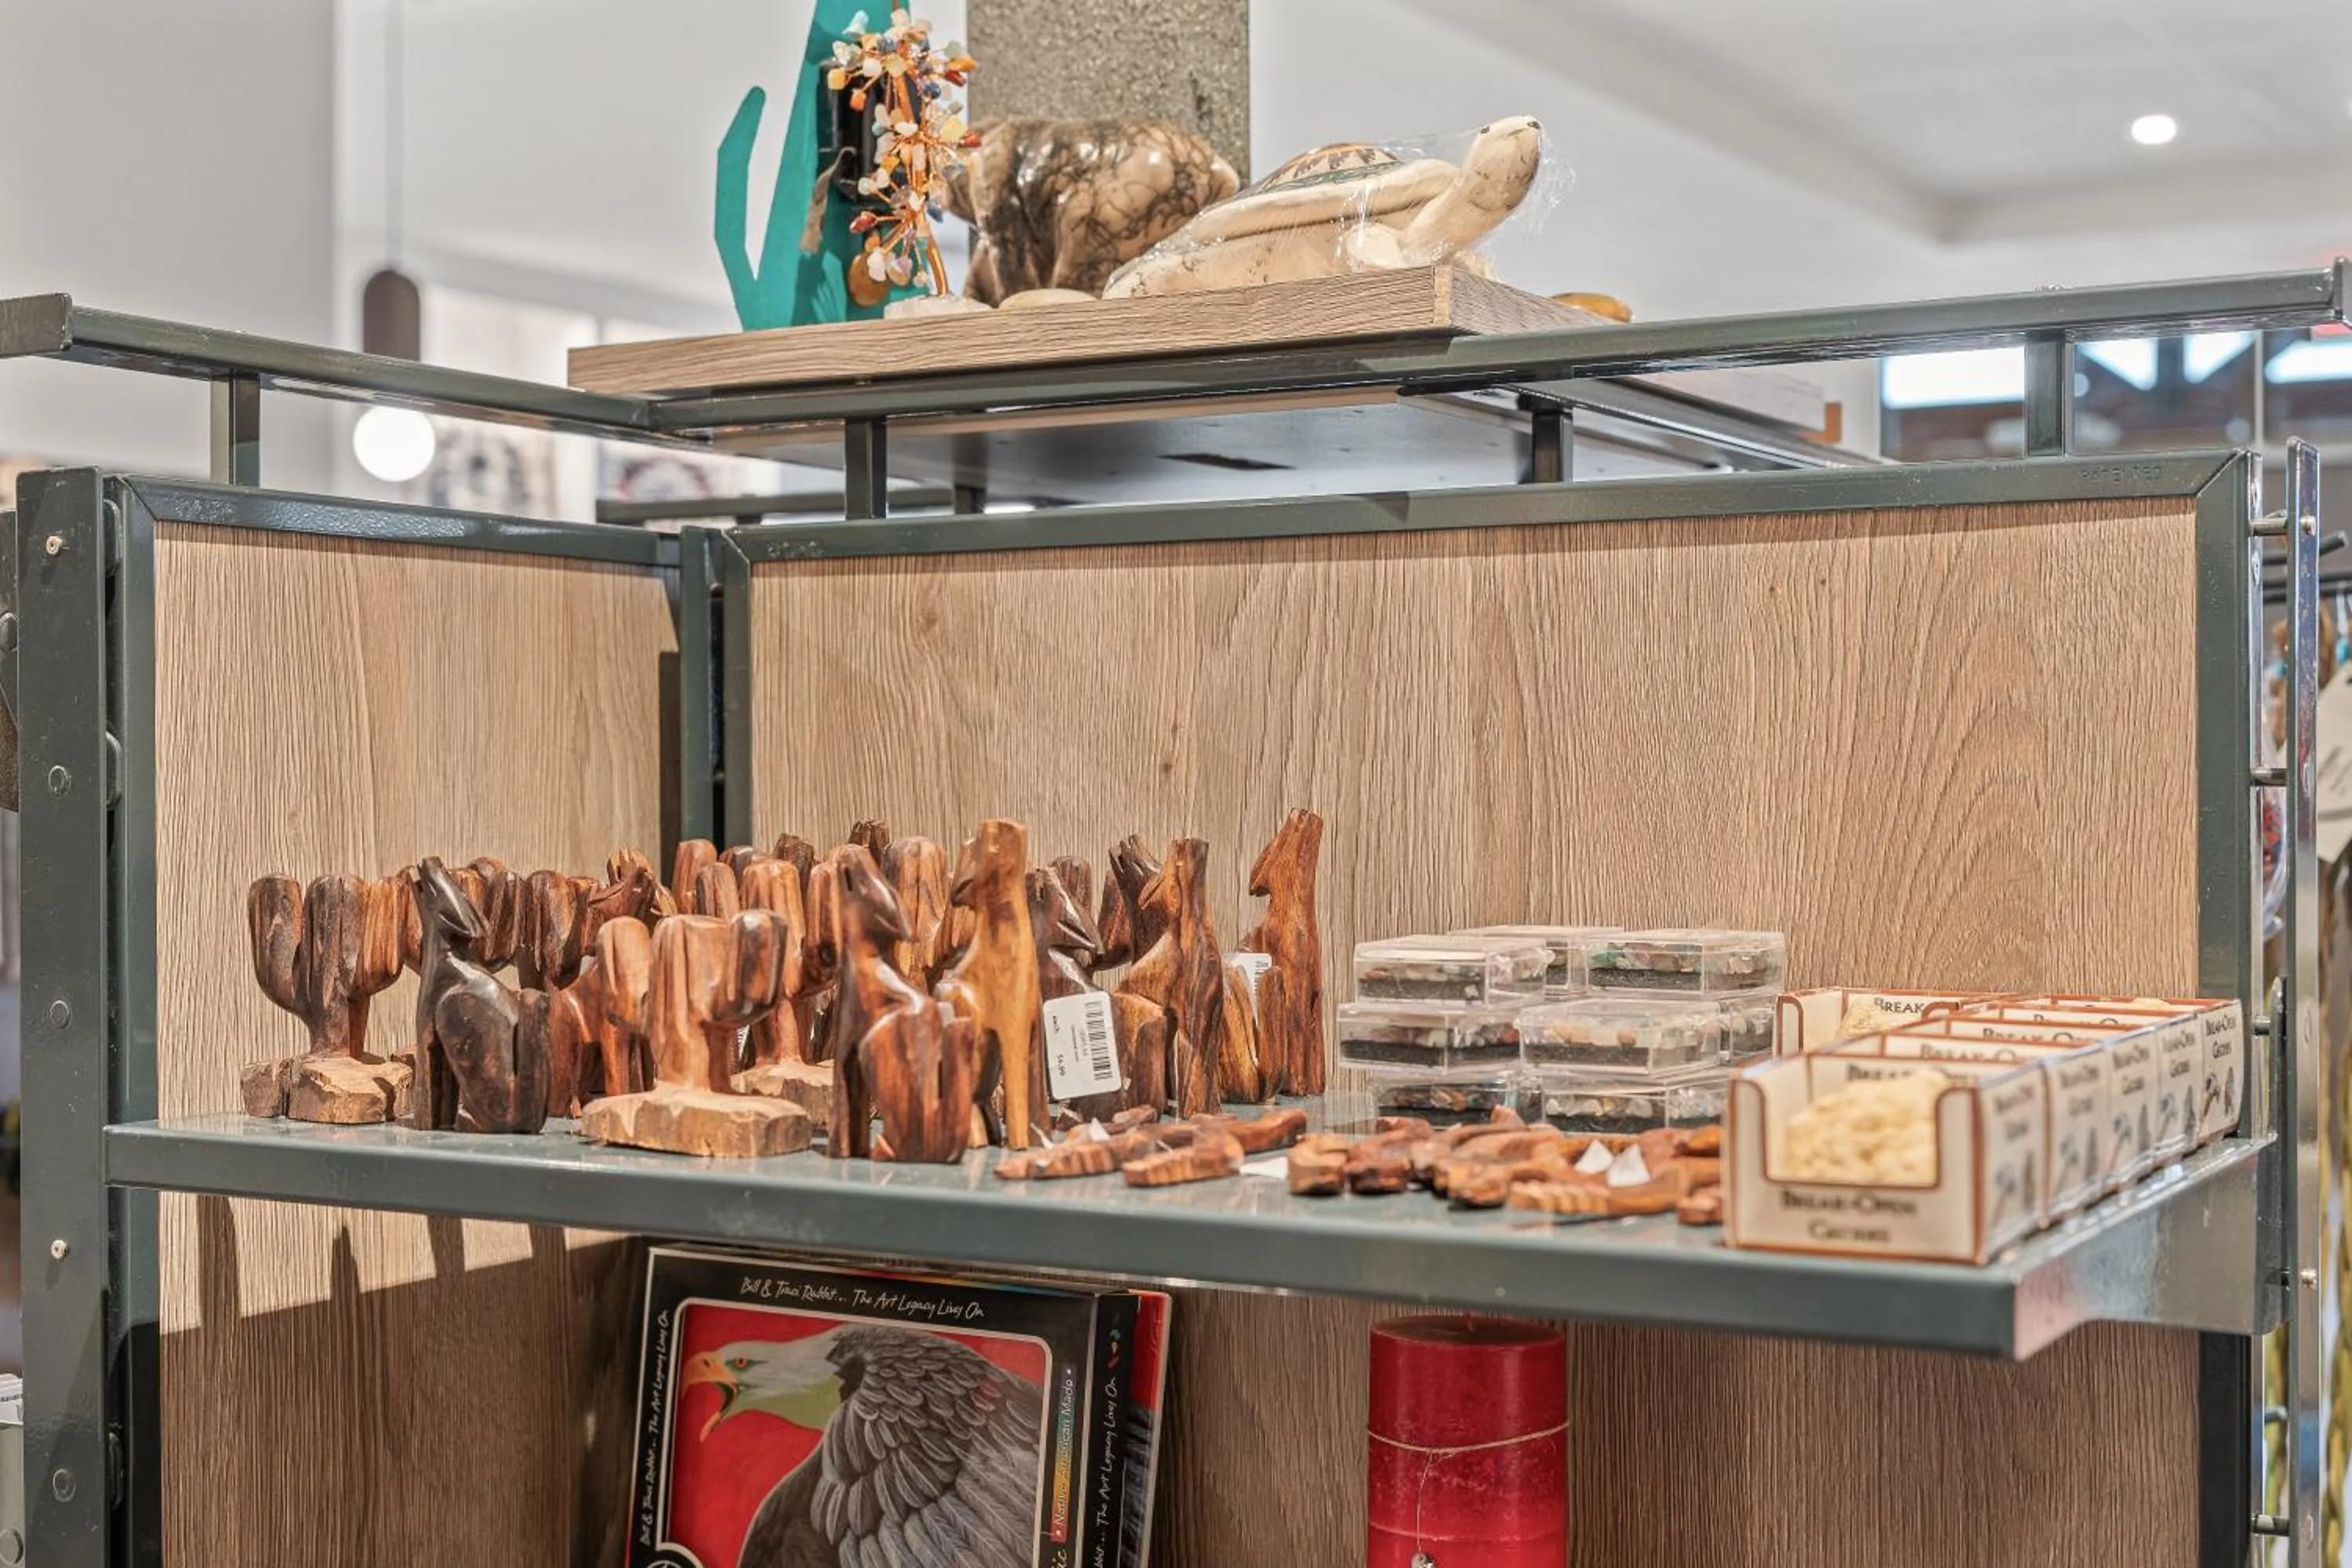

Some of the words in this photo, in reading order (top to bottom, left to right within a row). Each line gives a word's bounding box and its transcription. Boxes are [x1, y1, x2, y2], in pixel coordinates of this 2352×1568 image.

[740, 1276, 761, 1294] Bill
[760, 1279, 772, 1298] &
[852, 1289, 873, 1307] The
[873, 1293, 898, 1310] Art
[898, 1295, 936, 1319] Legacy
[938, 1299, 964, 1319] Lives
[965, 1301, 985, 1319] On
[658, 1309, 670, 1328] On
[652, 1354, 666, 1390] Legacy
[1061, 1379, 1073, 1415] Made
[1105, 1377, 1117, 1398] On
[651, 1390, 661, 1411] Art
[648, 1414, 659, 1433] The
[1099, 1432, 1117, 1472] Legacy
[1098, 1474, 1110, 1501] Art
[641, 1513, 653, 1526] &
[1097, 1504, 1109, 1527] The
